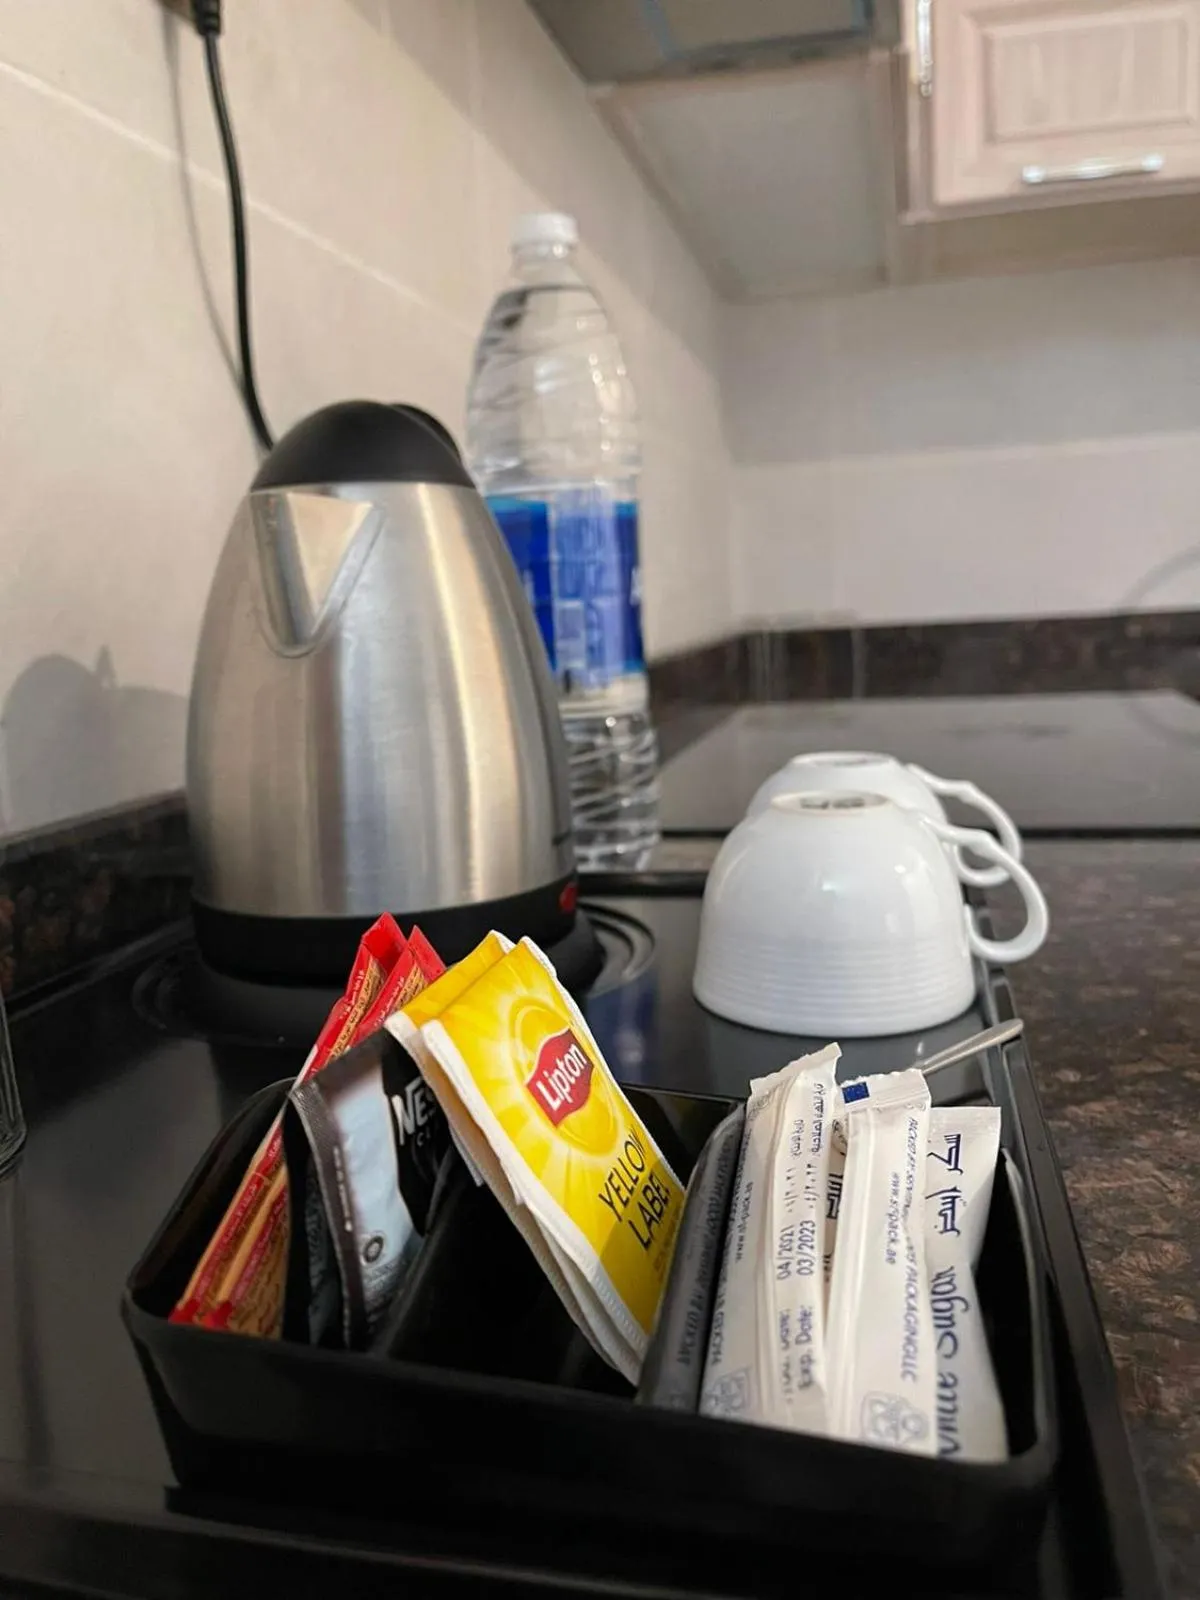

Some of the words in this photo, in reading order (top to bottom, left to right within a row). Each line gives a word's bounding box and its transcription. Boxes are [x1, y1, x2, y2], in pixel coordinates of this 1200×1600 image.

[536, 1044, 587, 1111] Lipton
[795, 1219, 816, 1277] 03/2023
[794, 1304, 814, 1346] Date:
